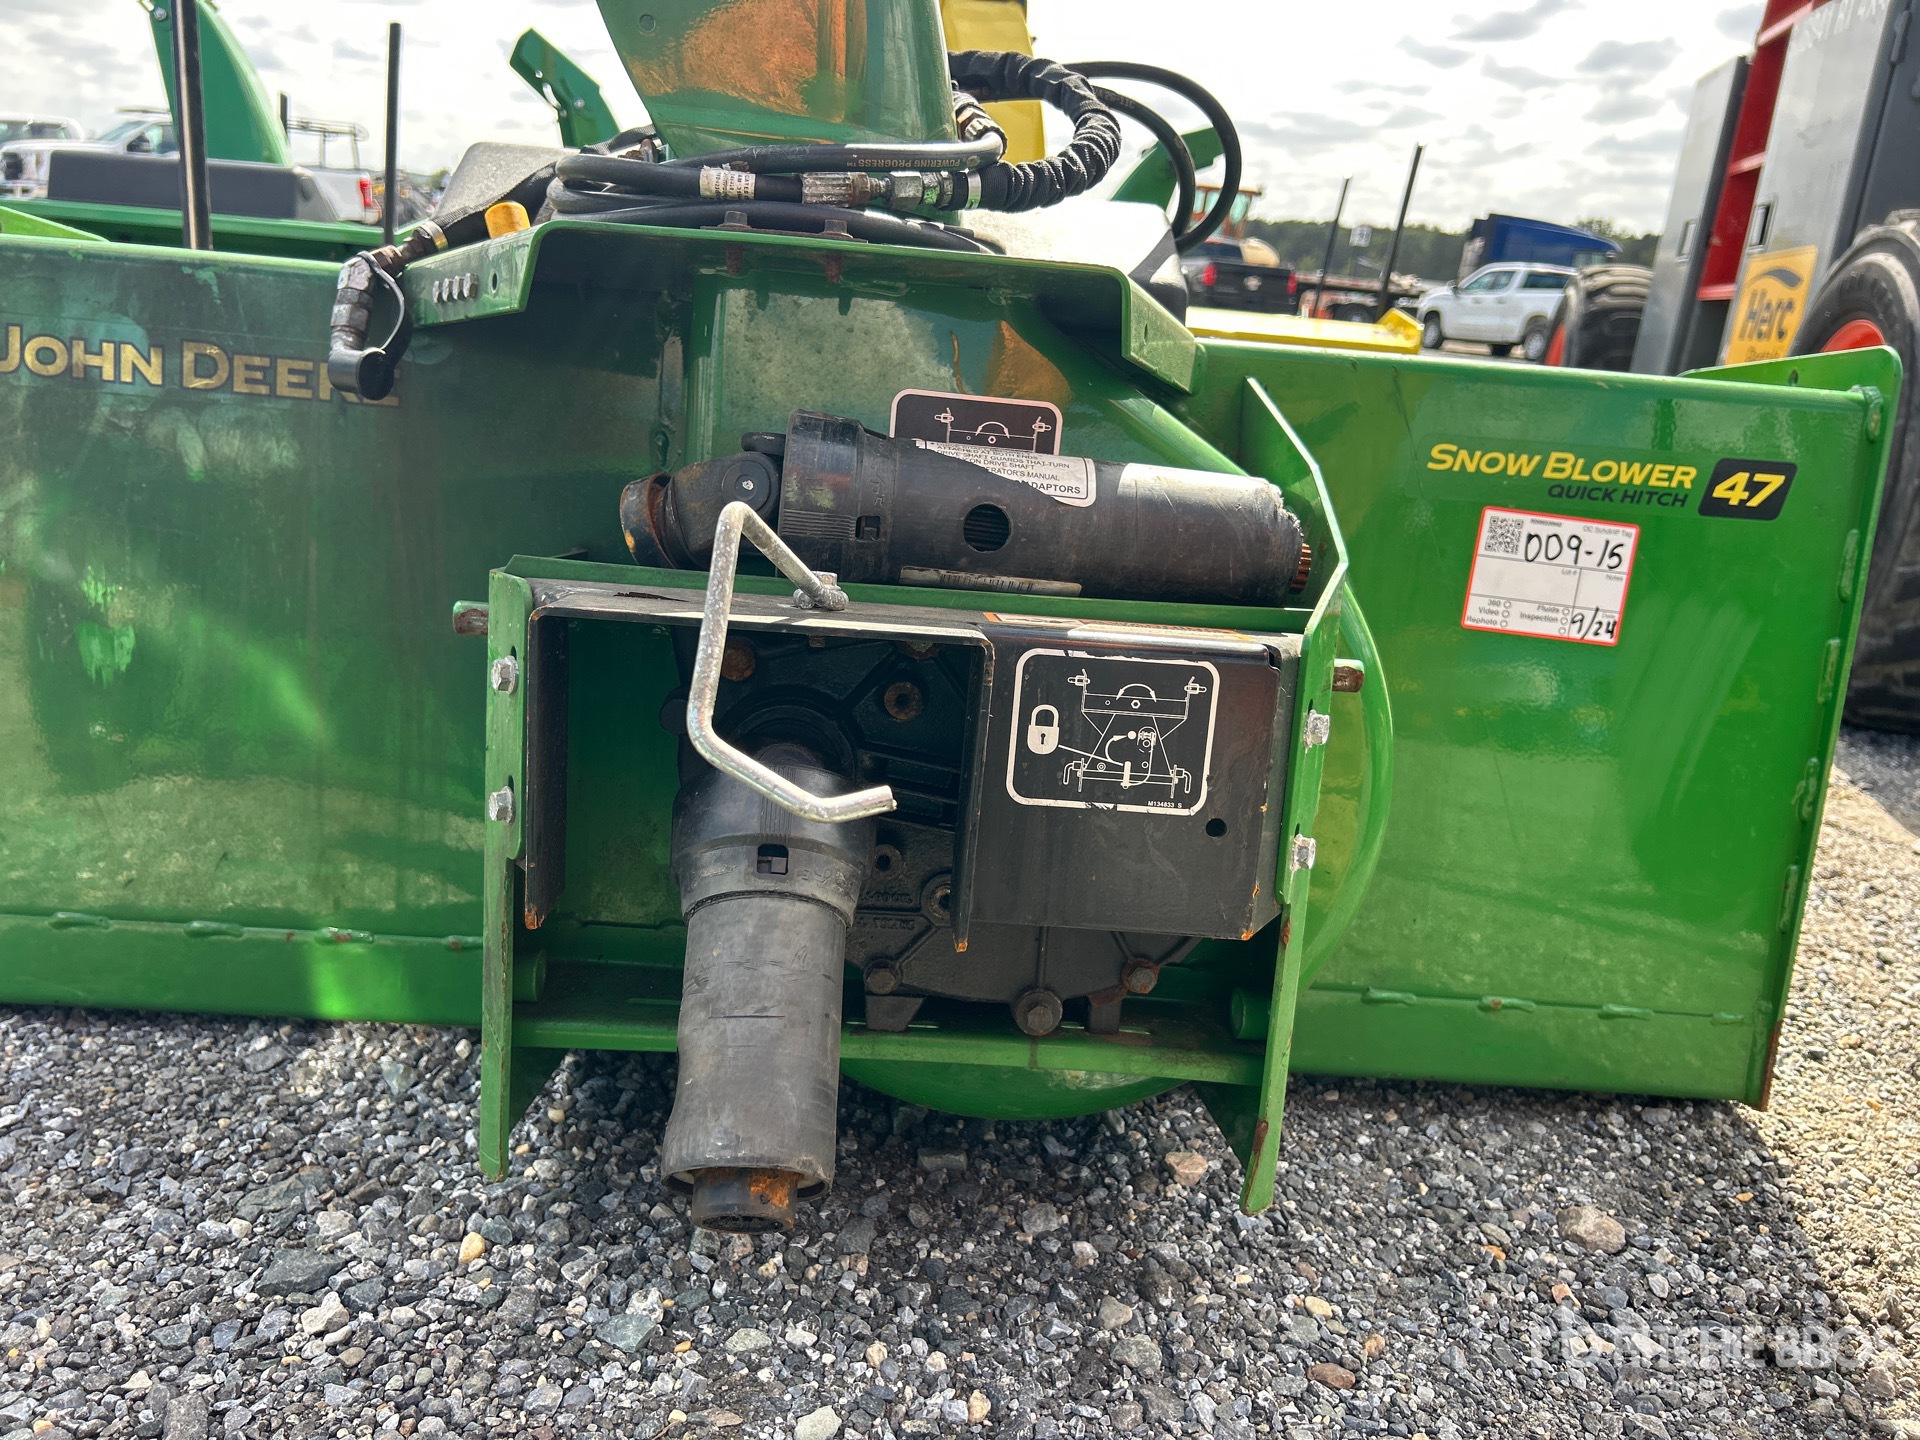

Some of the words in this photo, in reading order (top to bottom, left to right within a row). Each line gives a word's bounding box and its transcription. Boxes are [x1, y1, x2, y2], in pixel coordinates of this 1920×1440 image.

[858, 159, 912, 168] PROGRESS
[914, 159, 960, 168] POWERING
[1739, 288, 1794, 341] Herc
[0, 325, 163, 386] JOHN
[182, 340, 400, 406] DEE
[963, 452, 988, 460] SHAFT
[1048, 461, 1070, 469] TURN
[984, 460, 1007, 468] DRIVE
[1009, 462, 1035, 470] SHAFT
[1427, 443, 1542, 477] SNOW
[1543, 451, 1697, 489] BLOWER
[1027, 471, 1060, 482] MANUAL
[1029, 481, 1081, 495] DAPTORS
[1712, 471, 1786, 508] 47
[1548, 484, 1617, 503] QUICK
[1621, 488, 1689, 508] HITCH
[1524, 532, 1625, 570] 009-15
[1478, 606, 1499, 616] Video
[1537, 605, 1560, 613] Fluids
[1467, 615, 1498, 626] Rephoto
[1520, 612, 1558, 623] Inspection
[1570, 606, 1618, 639] 9/24
